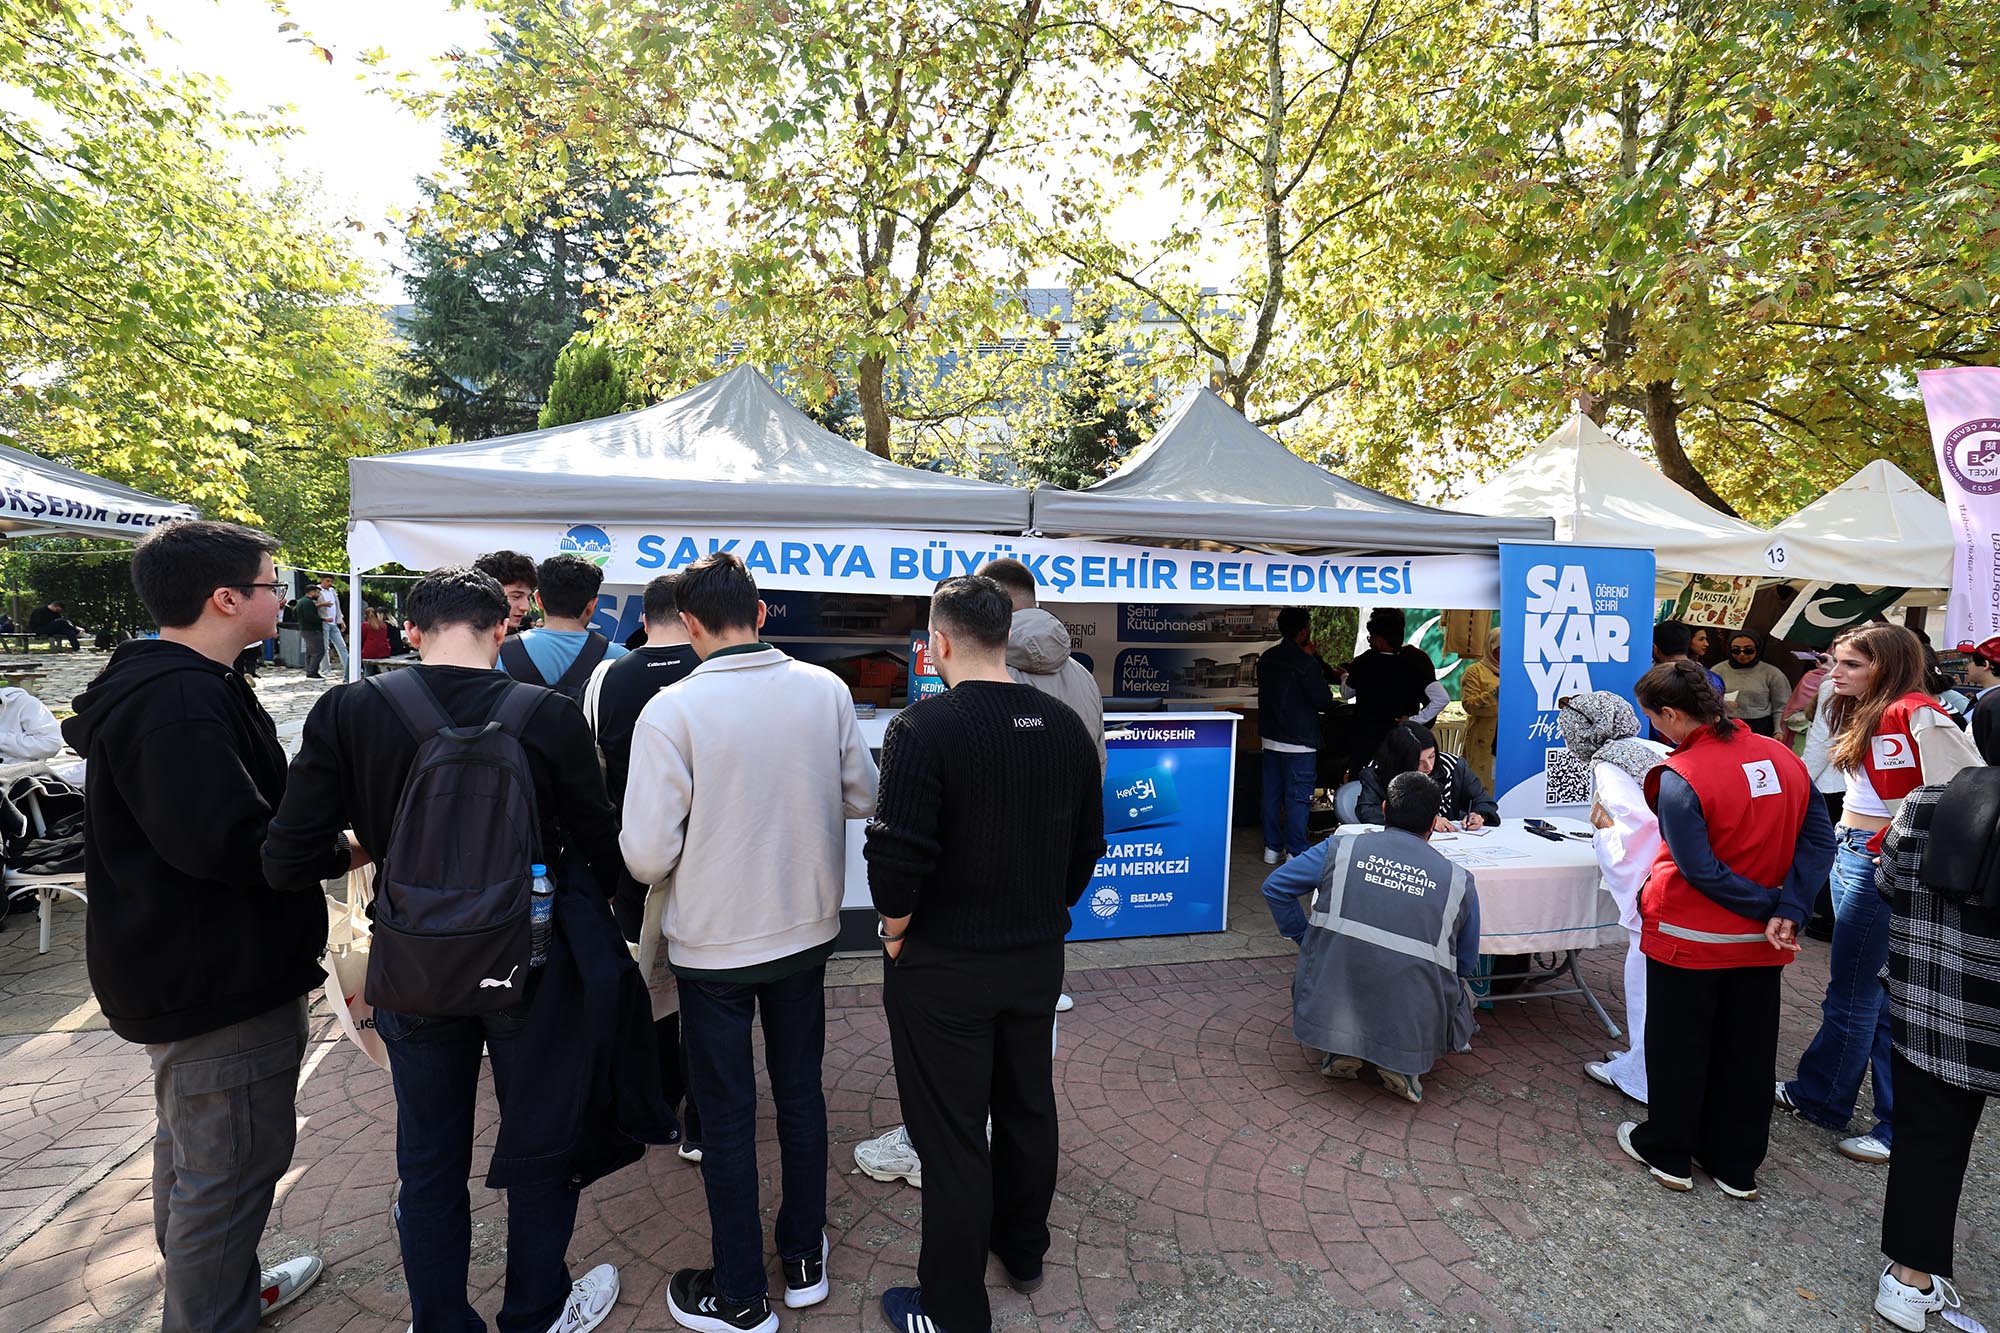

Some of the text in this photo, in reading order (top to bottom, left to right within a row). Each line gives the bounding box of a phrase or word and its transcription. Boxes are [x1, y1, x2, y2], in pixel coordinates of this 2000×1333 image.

[1768, 547, 1785, 564] 13
[1190, 559, 1414, 595] BELEDİYESİ
[1526, 564, 1595, 615] SA
[1595, 583, 1629, 599] ÖĞRENCİ
[1595, 598, 1619, 613] ŞEHRİ
[1693, 591, 1736, 605] PAKISTAN
[1127, 604, 1159, 617] Şehir
[1126, 617, 1207, 633] Kütüphanesi
[1523, 614, 1630, 663] KAR
[1123, 654, 1150, 666] AFA
[1122, 667, 1160, 679] Kültür
[1122, 679, 1170, 692] Merkezi
[1120, 856, 1190, 876] MERKEZİ
[1368, 854, 1428, 878] SAKARYA
[1356, 860, 1437, 890] BÜYÜKŞEHİR
[1364, 872, 1425, 897] BELEDİYESİ
[1130, 892, 1174, 903] BELPAŞ
